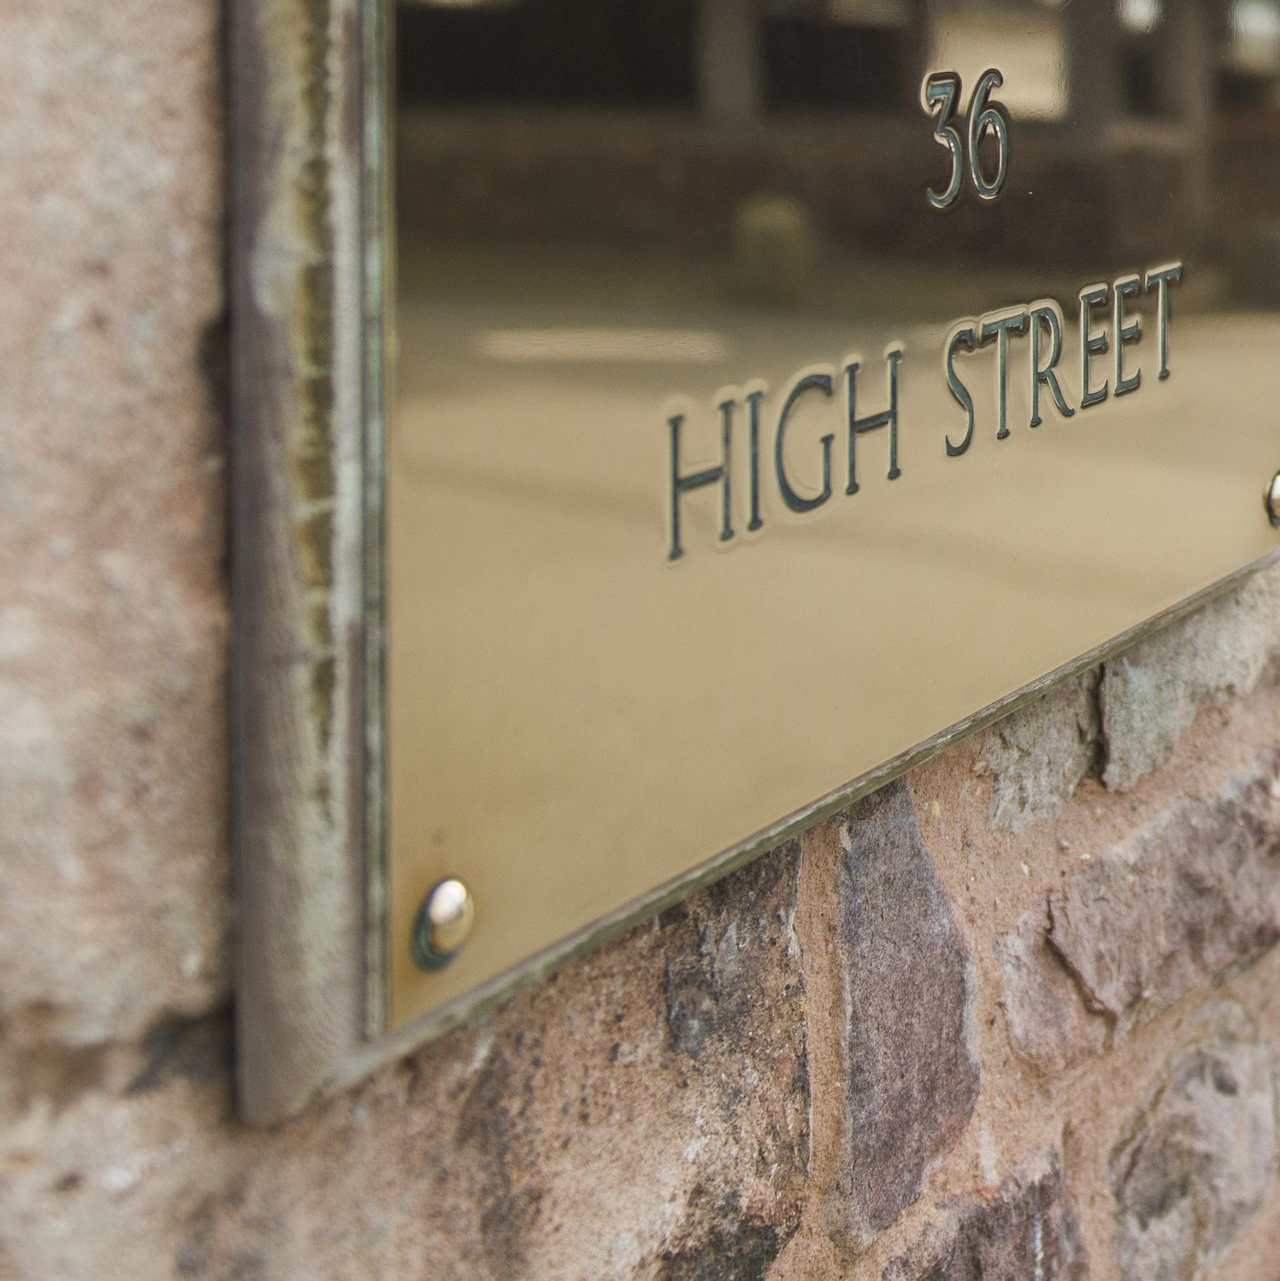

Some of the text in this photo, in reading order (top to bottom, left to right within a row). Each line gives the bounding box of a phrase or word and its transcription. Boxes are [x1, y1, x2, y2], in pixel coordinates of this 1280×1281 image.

[920, 68, 1008, 208] 36
[667, 263, 1182, 560] HIGH STREET
